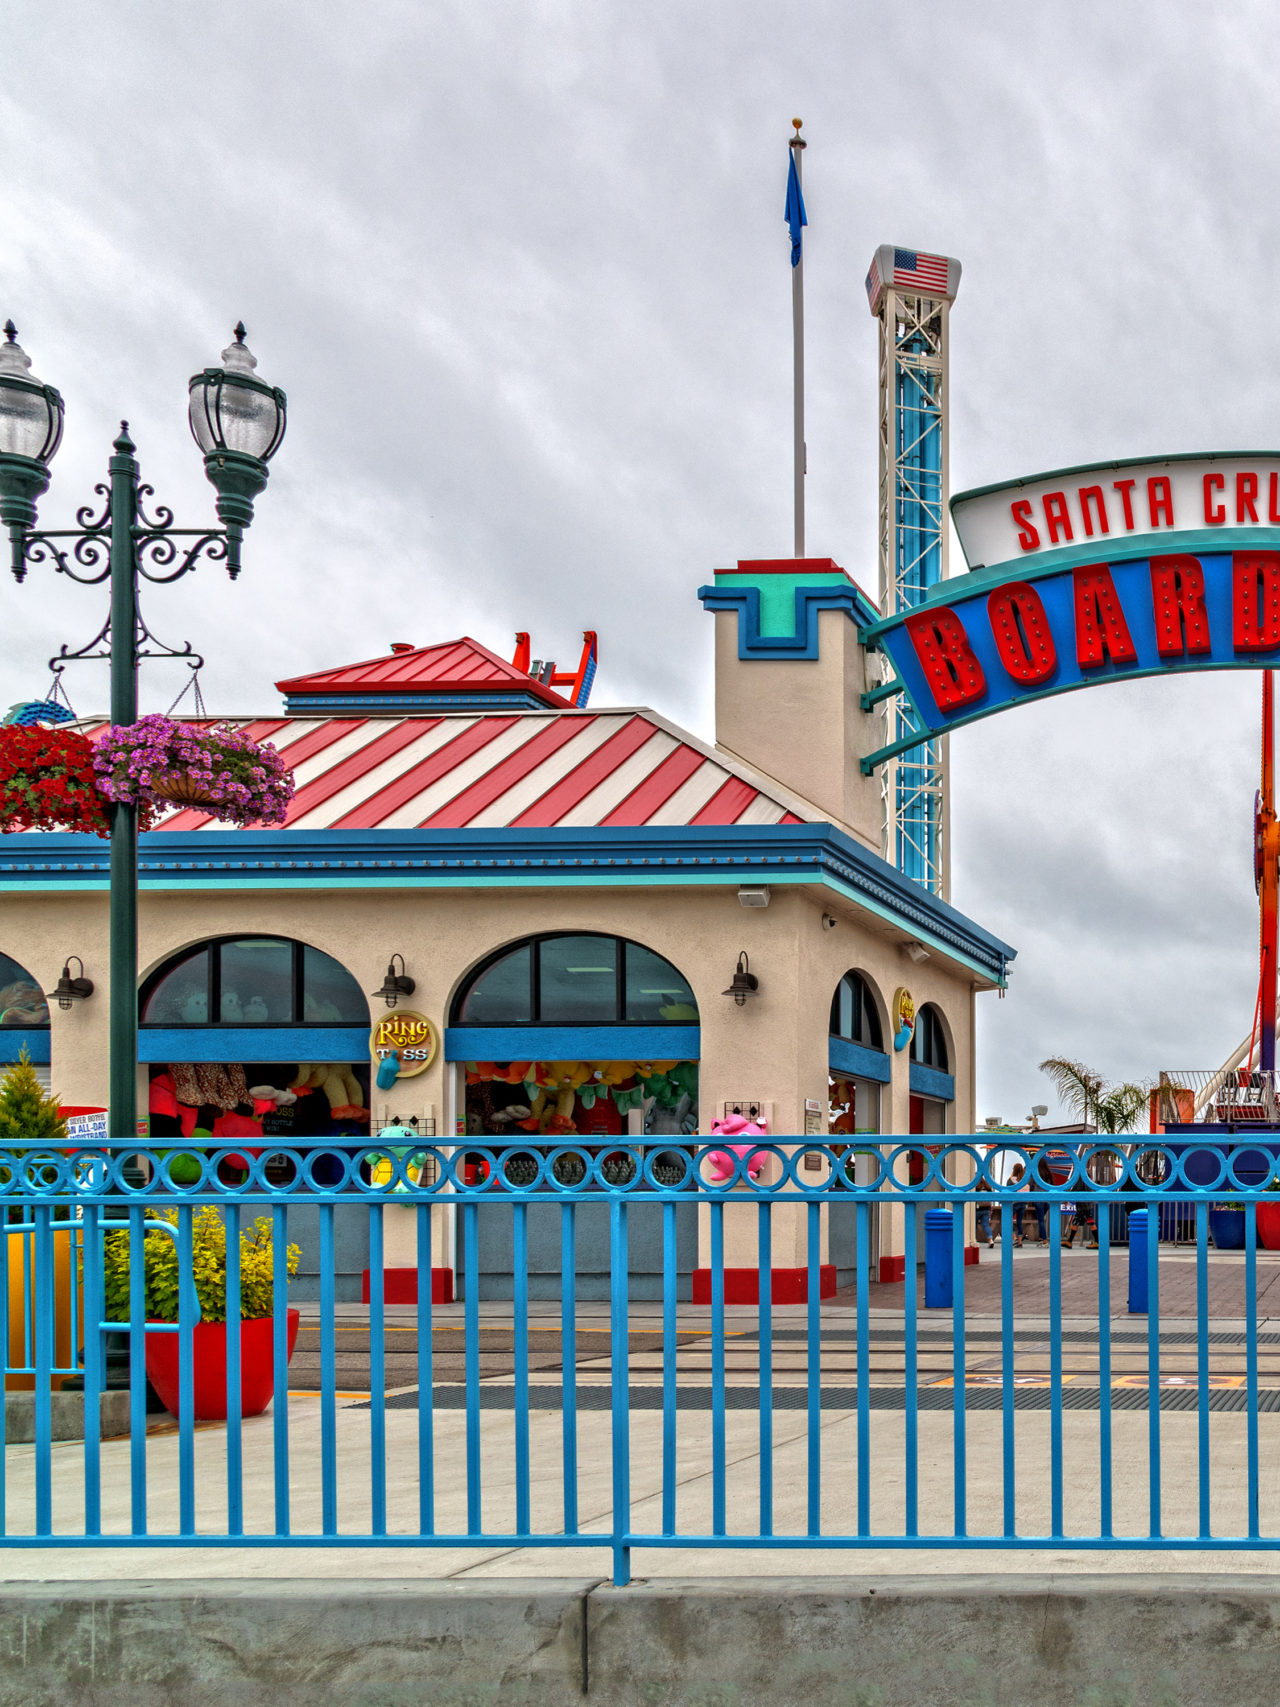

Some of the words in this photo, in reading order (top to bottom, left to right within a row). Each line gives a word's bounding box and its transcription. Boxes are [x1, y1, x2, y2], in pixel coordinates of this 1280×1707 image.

[1010, 476, 1174, 550] SANTA
[376, 1048, 428, 1061] TSS
[78, 1121, 106, 1133] ALL-DAY
